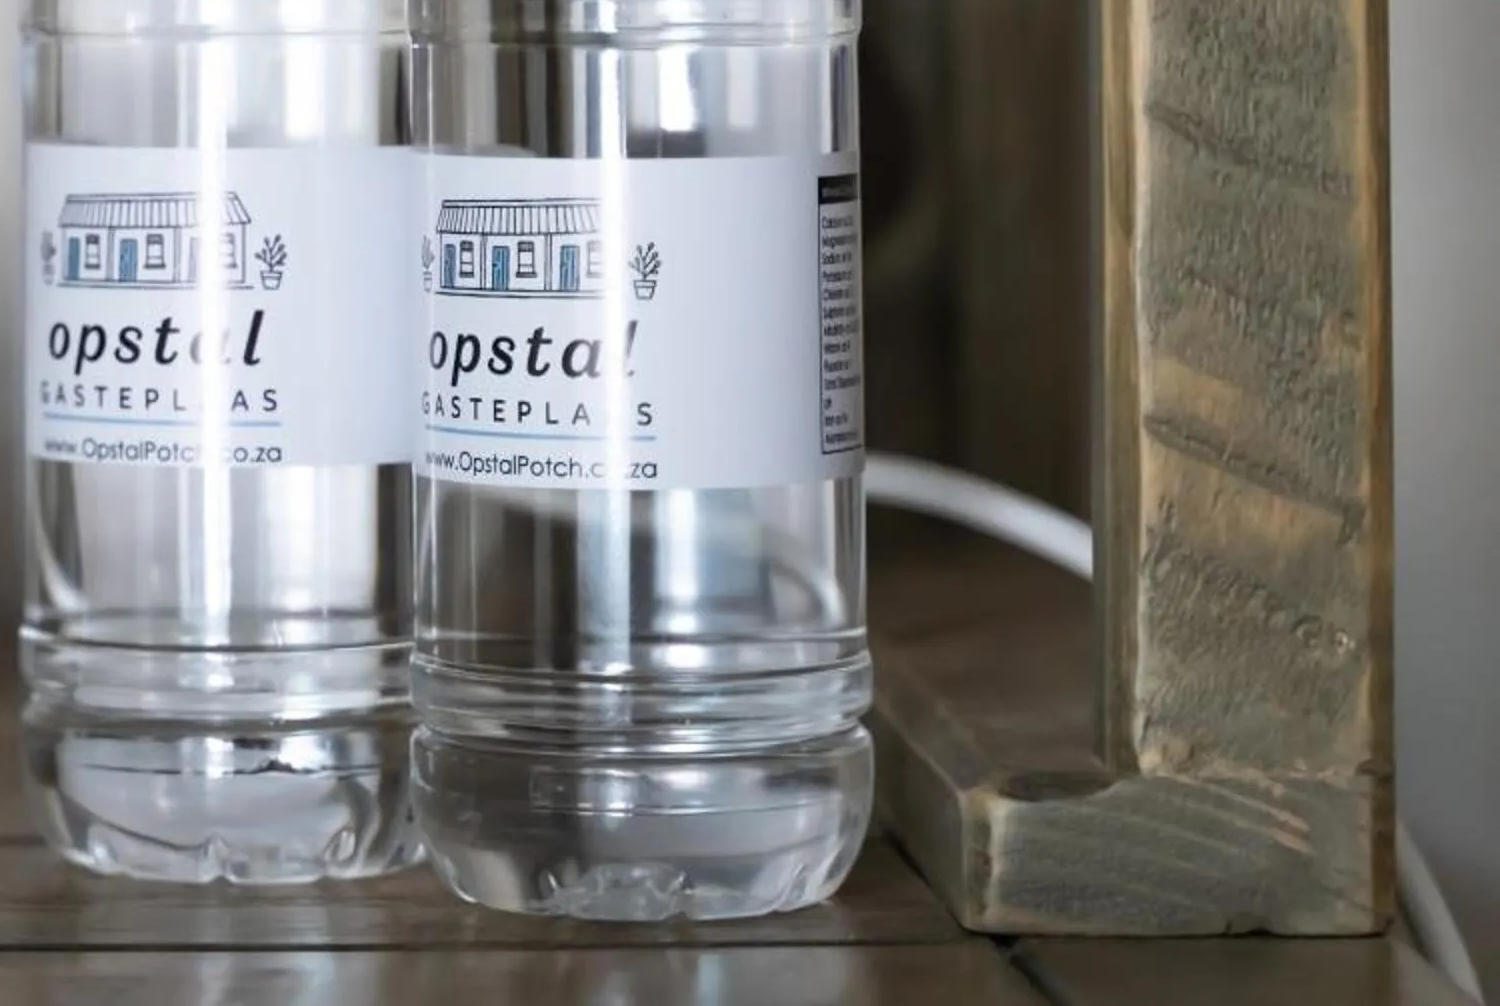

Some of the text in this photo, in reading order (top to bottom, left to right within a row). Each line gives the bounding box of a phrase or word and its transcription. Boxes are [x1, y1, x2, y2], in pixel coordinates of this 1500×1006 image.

[429, 319, 639, 387] opstal
[39, 380, 278, 412] GASTEPLAS
[421, 391, 654, 426] GASTEPLAS
[43, 437, 283, 464] www.OpstalPotco.za
[424, 450, 658, 479] www.OpstalPotch.cza
